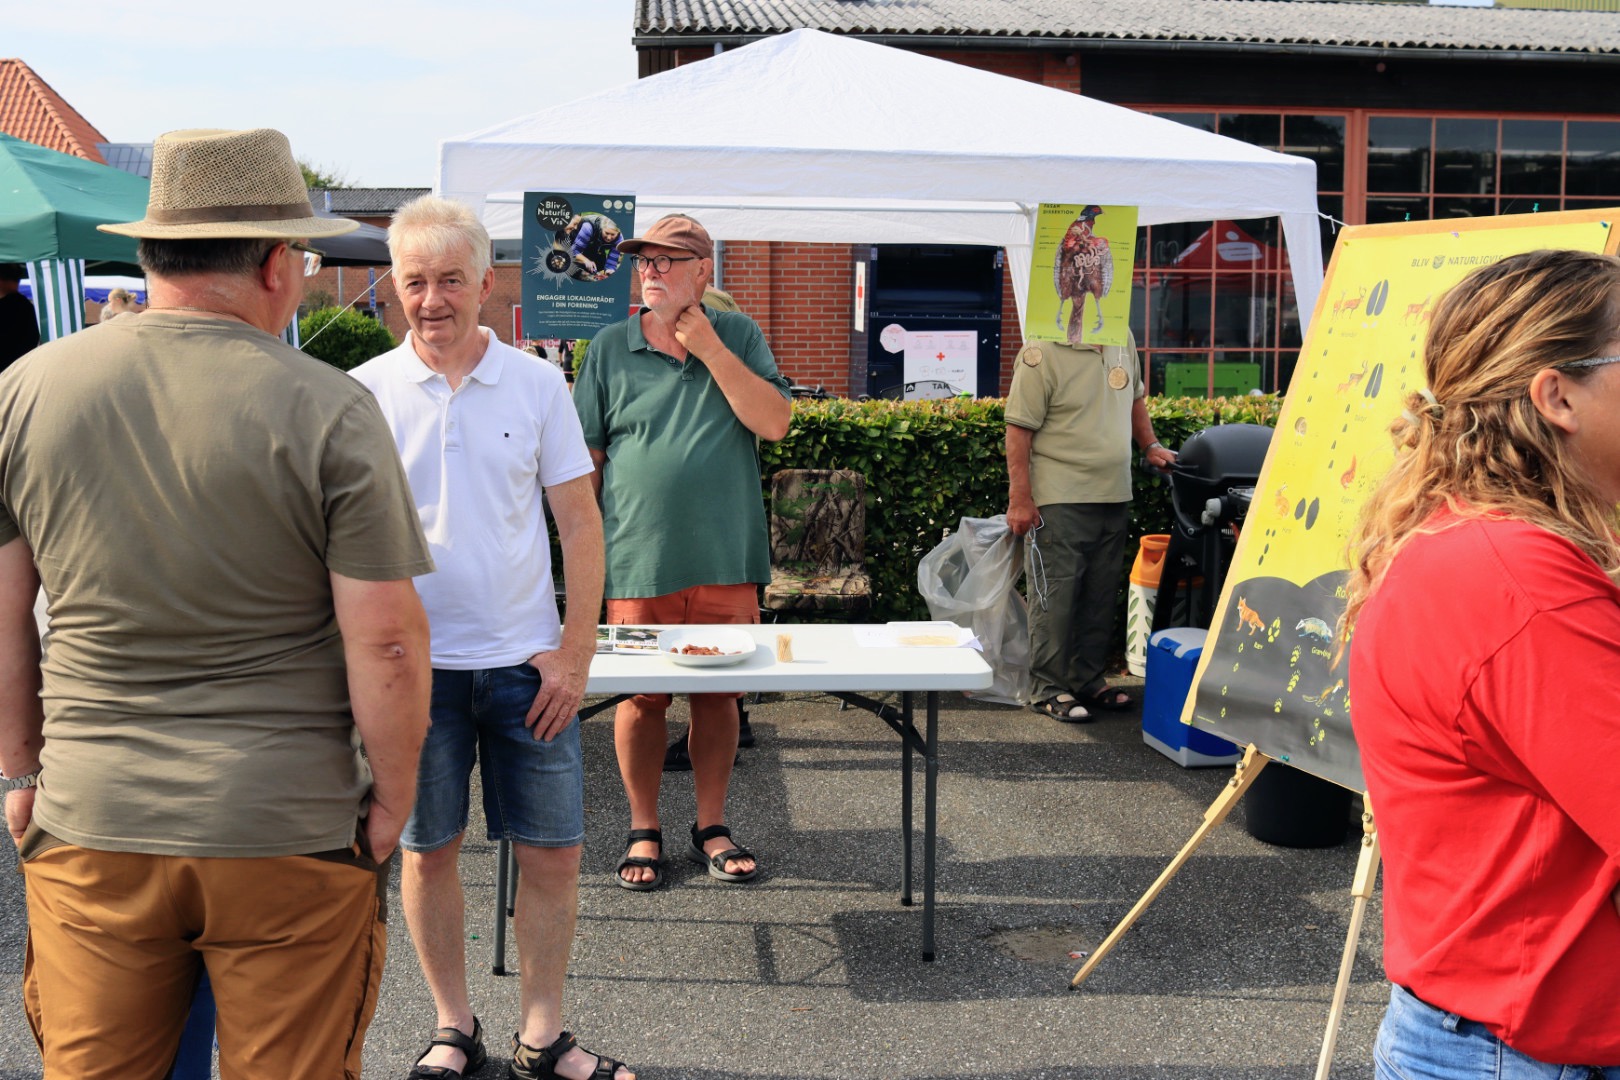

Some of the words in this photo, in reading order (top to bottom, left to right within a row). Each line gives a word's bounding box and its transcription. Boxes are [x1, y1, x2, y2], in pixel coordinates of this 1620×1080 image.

[545, 201, 561, 210] Bliv
[537, 208, 571, 219] Naturlig
[551, 217, 563, 226] Vis
[1411, 258, 1430, 267] BLIV
[567, 295, 615, 304] LOKALOMRÅDET
